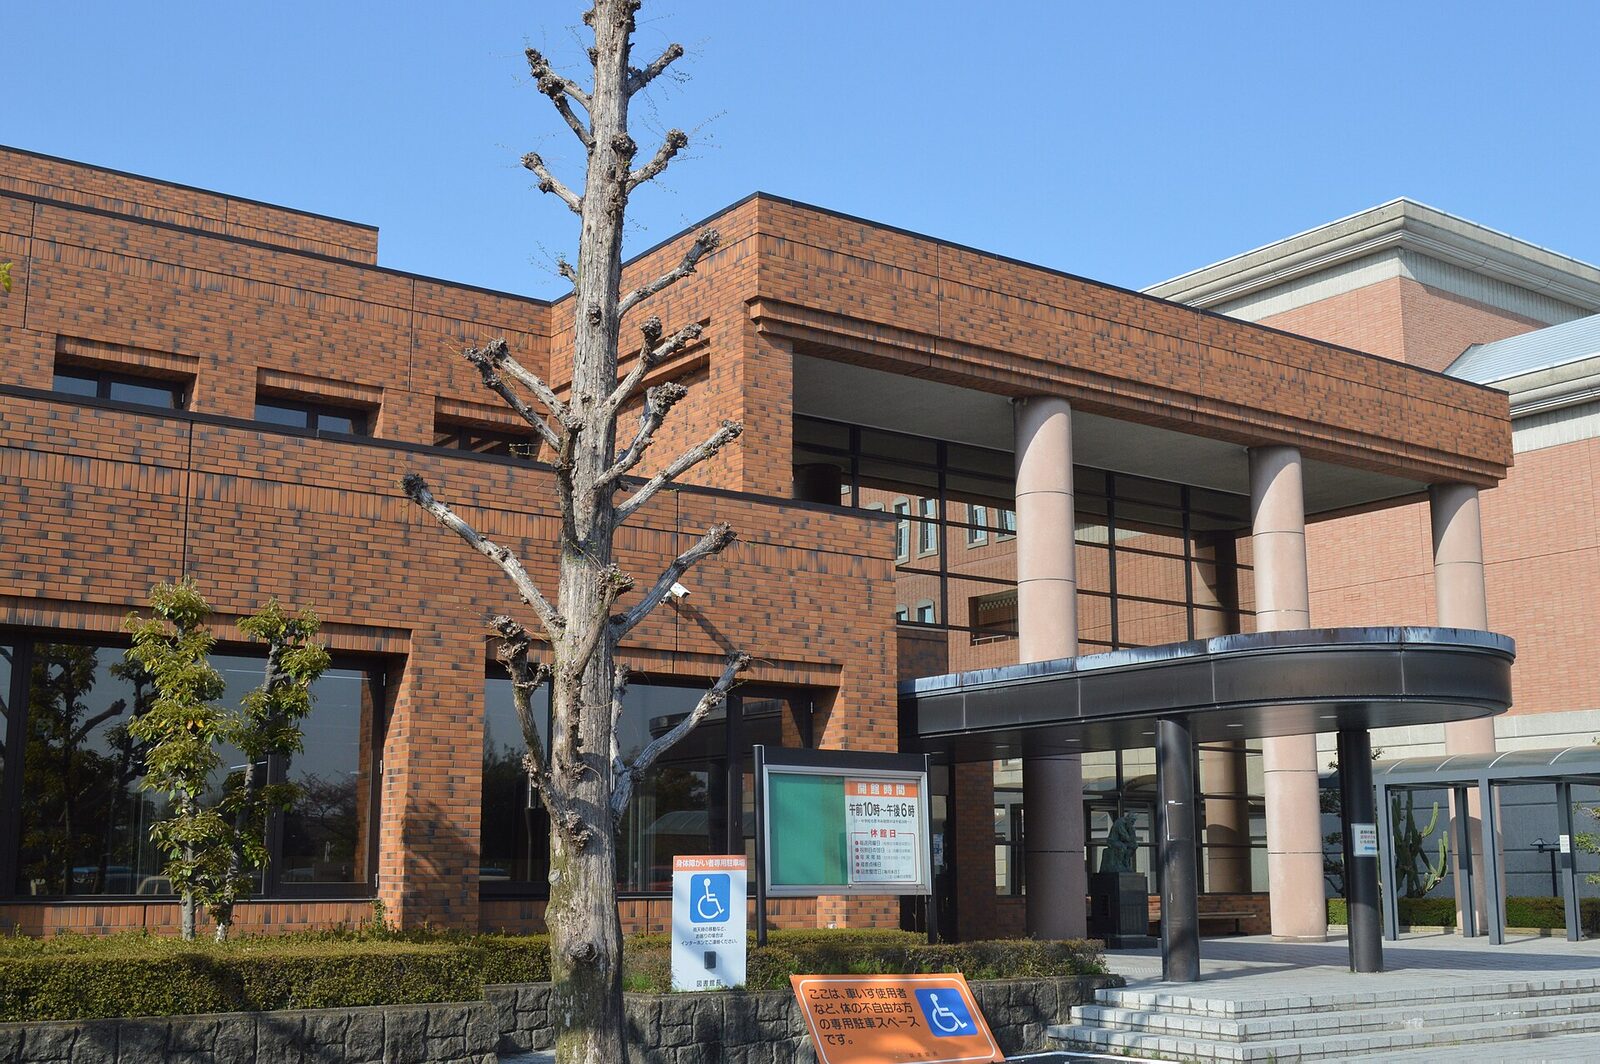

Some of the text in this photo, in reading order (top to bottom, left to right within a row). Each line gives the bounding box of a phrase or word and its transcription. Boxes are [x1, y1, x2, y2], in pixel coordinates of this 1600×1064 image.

[870, 829, 896, 838] 休館日
[808, 988, 908, 1000] ここは、車いす使用者
[813, 1002, 913, 1015] など、体の不自由な方
[819, 1016, 920, 1031] の専用駐車スペース
[824, 1033, 854, 1046] です。
